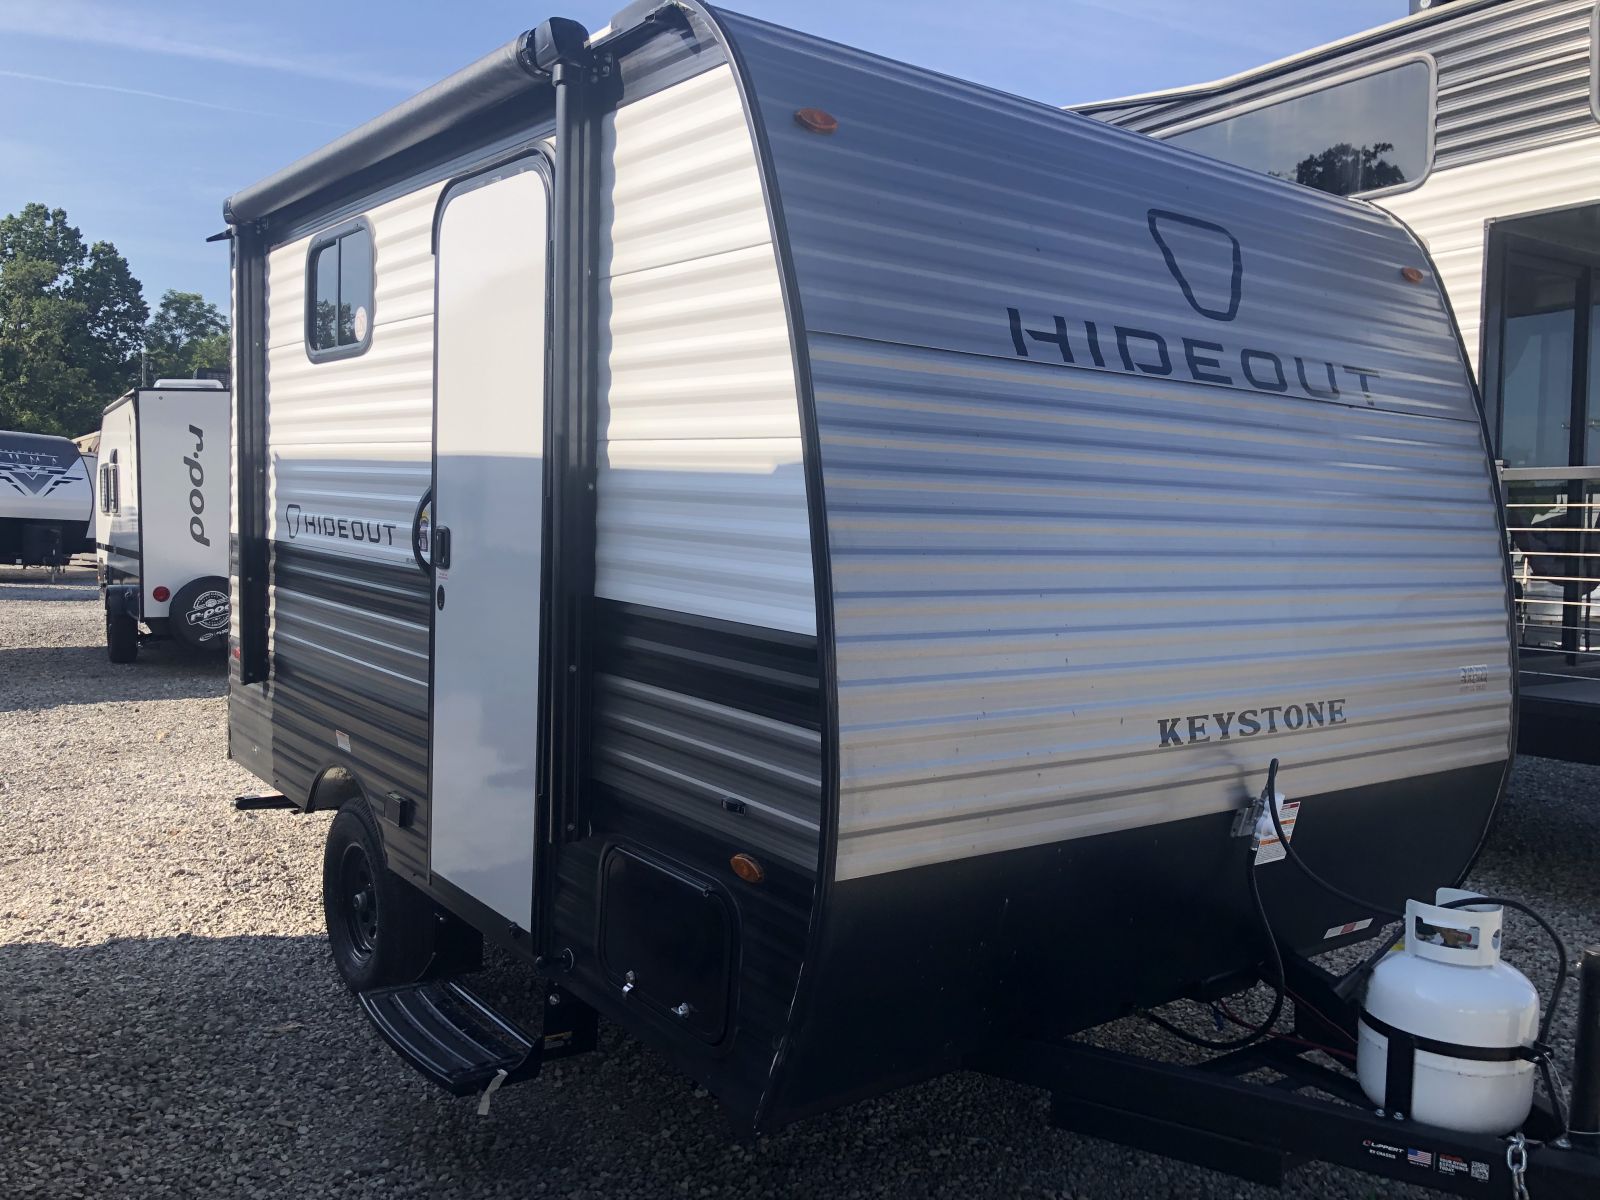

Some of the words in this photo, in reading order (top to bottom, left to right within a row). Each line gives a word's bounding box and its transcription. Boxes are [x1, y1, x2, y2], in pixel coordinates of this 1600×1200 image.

[1007, 307, 1380, 406] HIDEOUT
[304, 514, 396, 546] HIDEOUT
[1158, 699, 1347, 748] KEYSTONE
